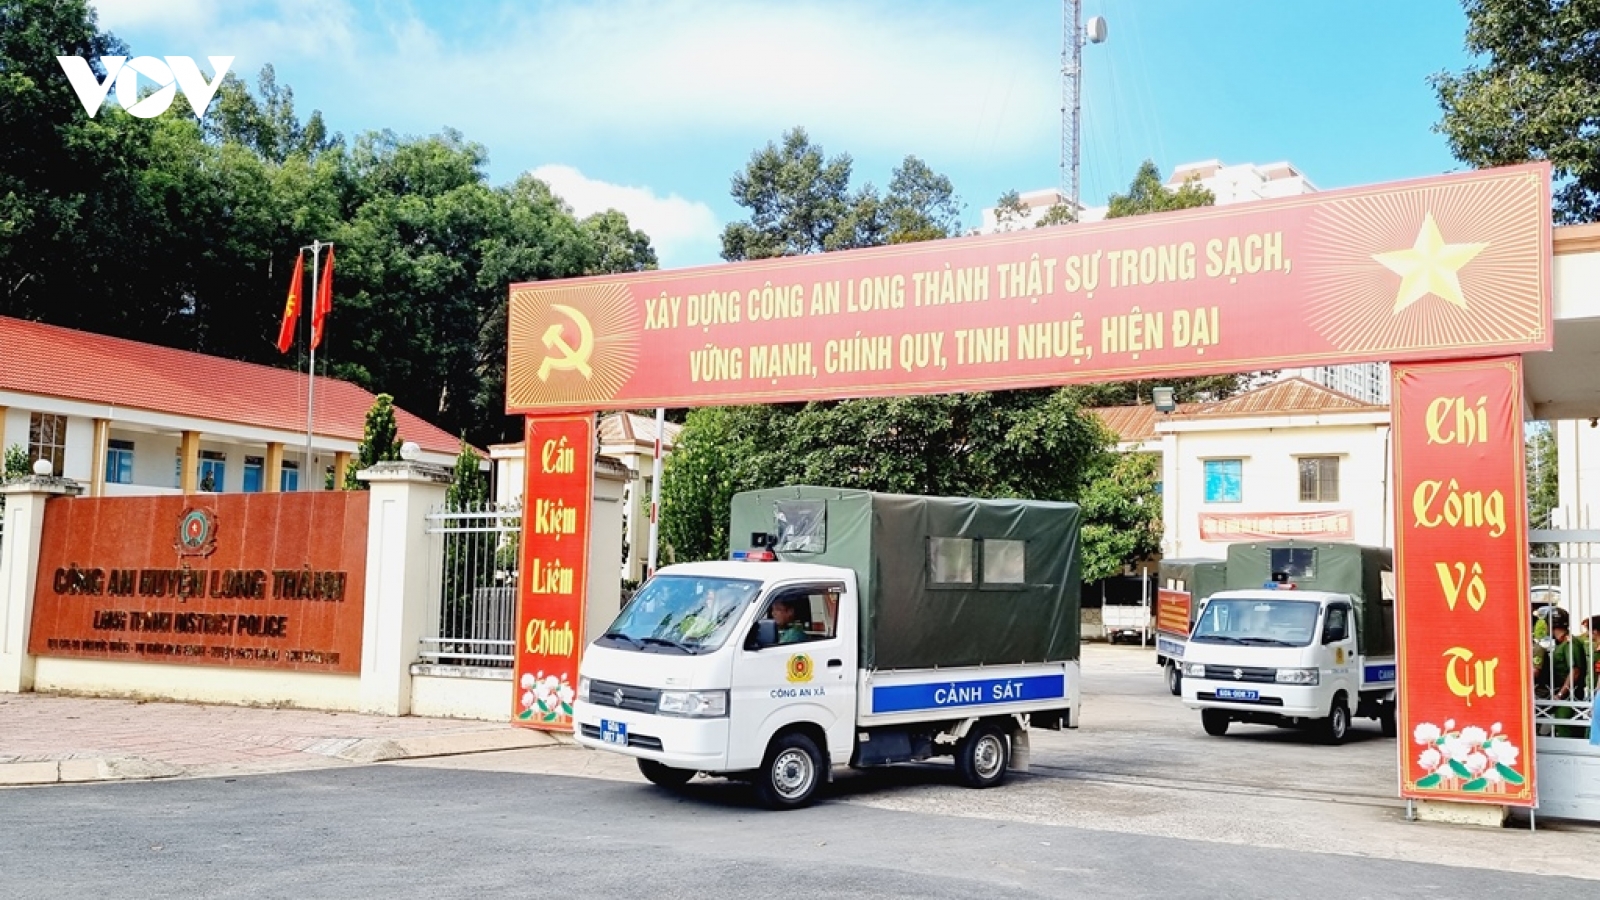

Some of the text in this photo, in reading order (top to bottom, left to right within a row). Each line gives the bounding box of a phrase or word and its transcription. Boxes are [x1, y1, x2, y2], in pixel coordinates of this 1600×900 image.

[644, 231, 1292, 332] XÂY DỰNG CÔNG AN LONG THÀNH THẬT SỰ TRONG SẠCH,
[690, 305, 1220, 384] VỮNG MẠNH, CHÍNH QUY, TINH NHUỆ, HIỆN ĐẠI
[1425, 395, 1488, 447] Chí
[541, 436, 574, 474] Cần
[535, 498, 576, 541] Kiệm
[1412, 478, 1506, 538] Công
[53, 562, 347, 603] CÔNG AN HUYỆN LONG THÀNH
[532, 558, 573, 595] Liêm
[1435, 561, 1487, 612] Vô
[237, 616, 288, 638] POLICE
[525, 618, 574, 659] Chính
[770, 686, 797, 698] CÔNG
[799, 688, 812, 696] AN
[934, 680, 1023, 704] CẢNH SÁT
